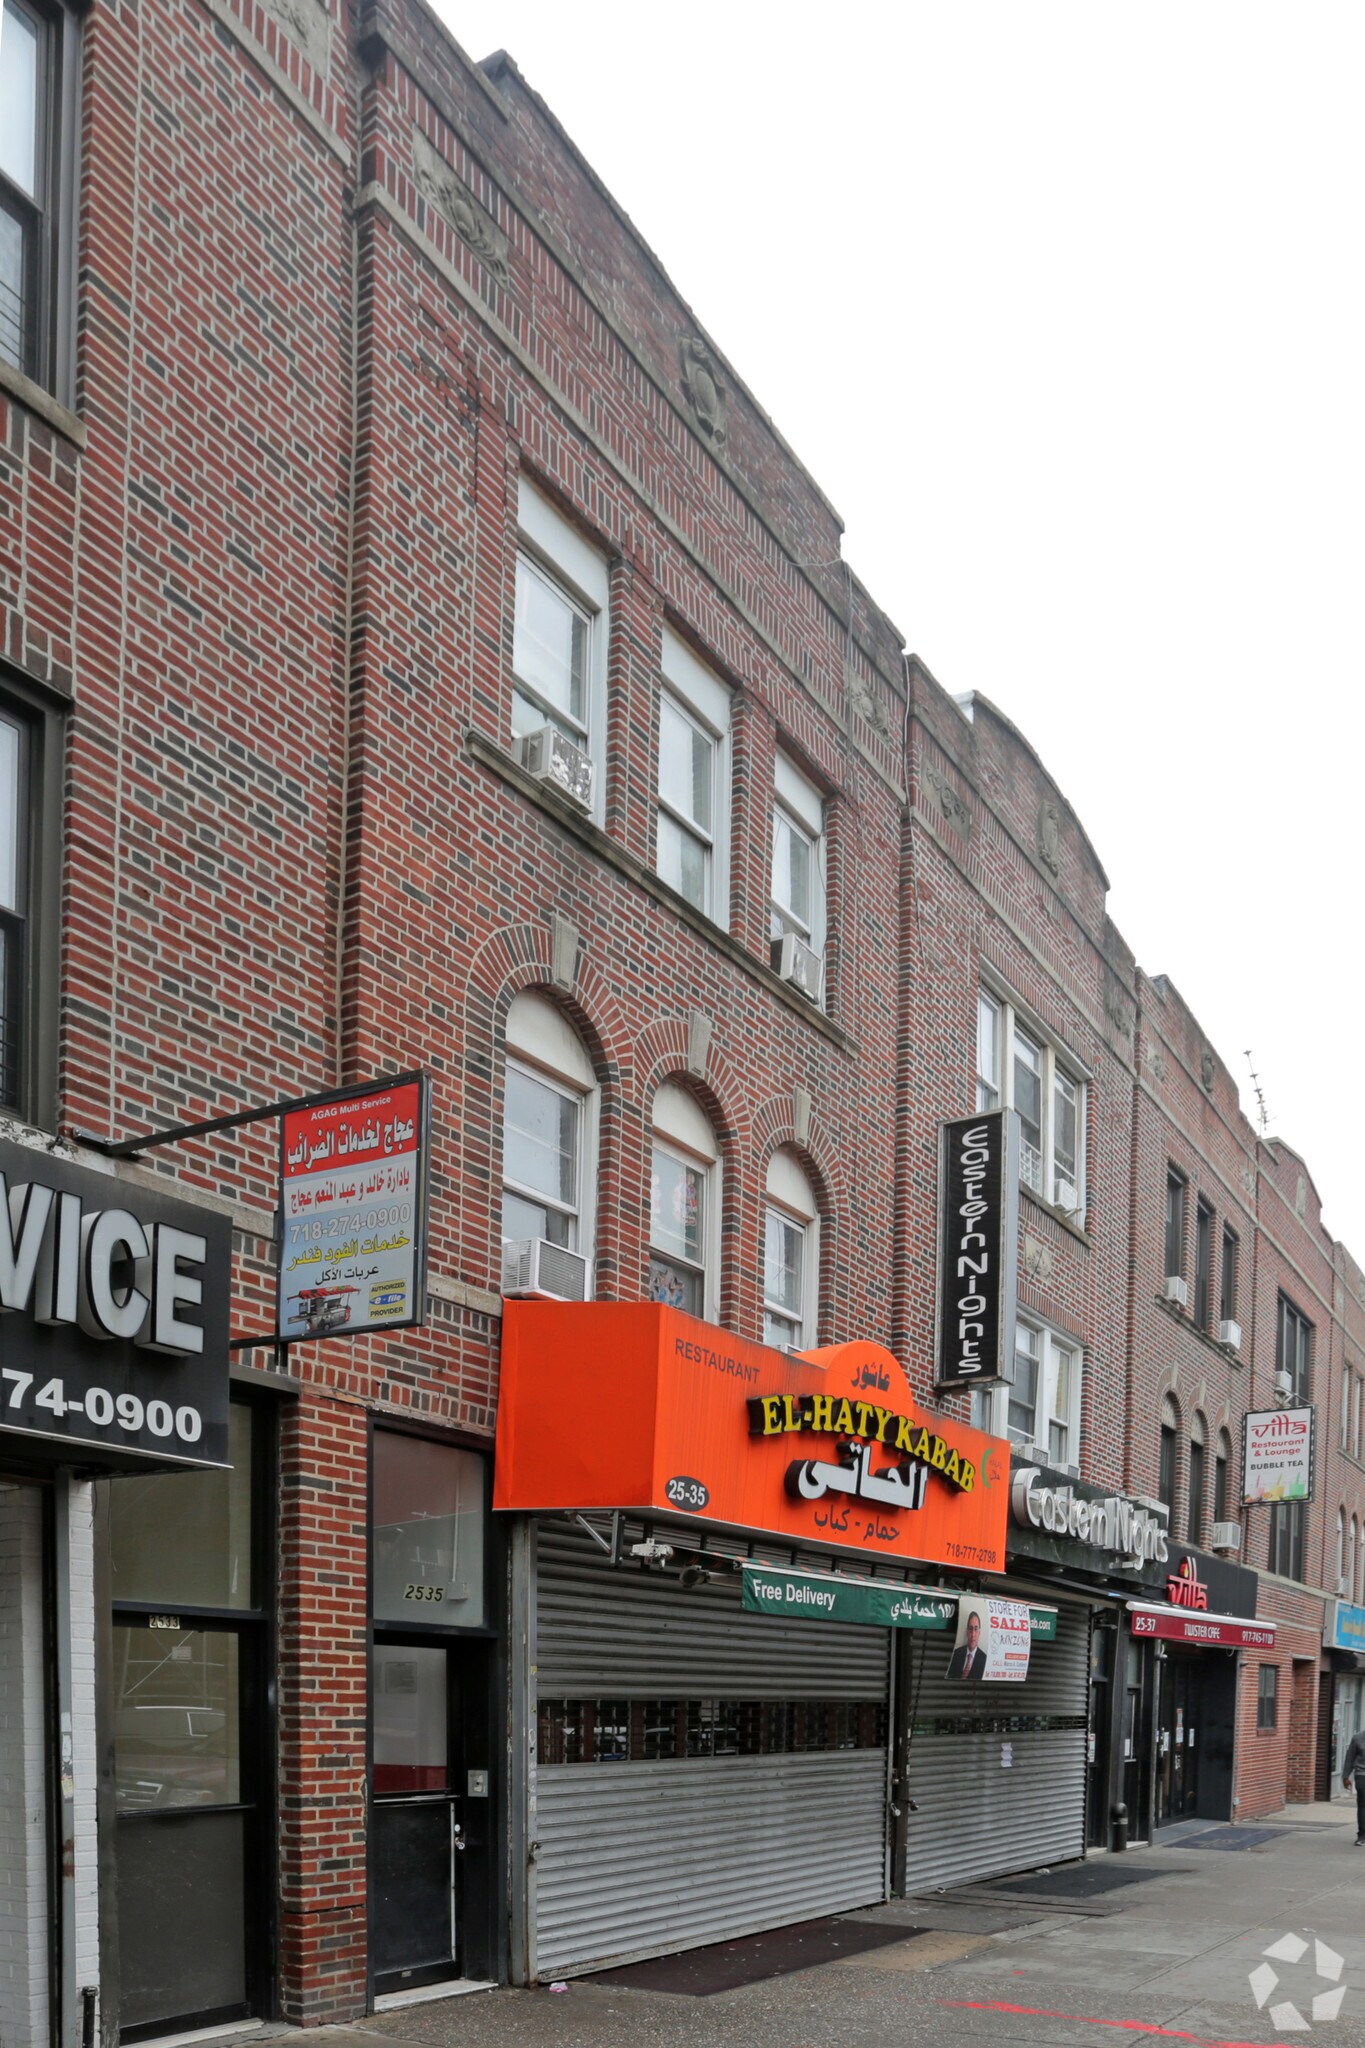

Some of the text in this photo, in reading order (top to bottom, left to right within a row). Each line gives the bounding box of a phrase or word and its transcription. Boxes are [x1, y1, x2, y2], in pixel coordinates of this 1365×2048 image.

[311, 1097, 391, 1120] AGAG Multi Service
[288, 1115, 414, 1172] عجاج لخدمات الضرائب
[339, 1182, 356, 1203] عبد
[959, 1125, 989, 1250] Eastern
[291, 1189, 312, 1214] عجاج
[290, 1203, 411, 1244] 718-274-0900
[325, 1238, 358, 1265] الفود
[361, 1230, 410, 1254] خدمات
[0, 1170, 207, 1356] VICE
[344, 1266, 379, 1280] عربات
[371, 1282, 405, 1292] AUTHORIZED
[370, 1307, 403, 1317] PROVIDER
[957, 1252, 988, 1374] Nights
[675, 1338, 760, 1384] RESTAURANT
[851, 1361, 891, 1392] عاشور
[2, 1367, 202, 1443] 74-0900
[759, 1394, 976, 1493] EL-HATY KABAB
[1251, 1438, 1305, 1449] Restaurant
[1265, 1448, 1300, 1456] Lounge
[1250, 1461, 1284, 1470] BUBBLE
[668, 1479, 706, 1505] 25-35
[863, 1515, 900, 1541] حمام
[1012, 1467, 1168, 1571] Eastern Nights
[946, 1543, 996, 1564] 718-777-2798
[405, 1585, 443, 1601] 2535
[752, 1579, 836, 1612] Free Delivery
[891, 1597, 912, 1621] بلدي
[914, 1596, 937, 1617] لحمة
[989, 1601, 1028, 1617] STORE FOR
[150, 1615, 178, 1628] 2533
[990, 1616, 1029, 1632] SALE
[1135, 1617, 1156, 1632] 25-37
[1184, 1623, 1207, 1637] TWISTER
